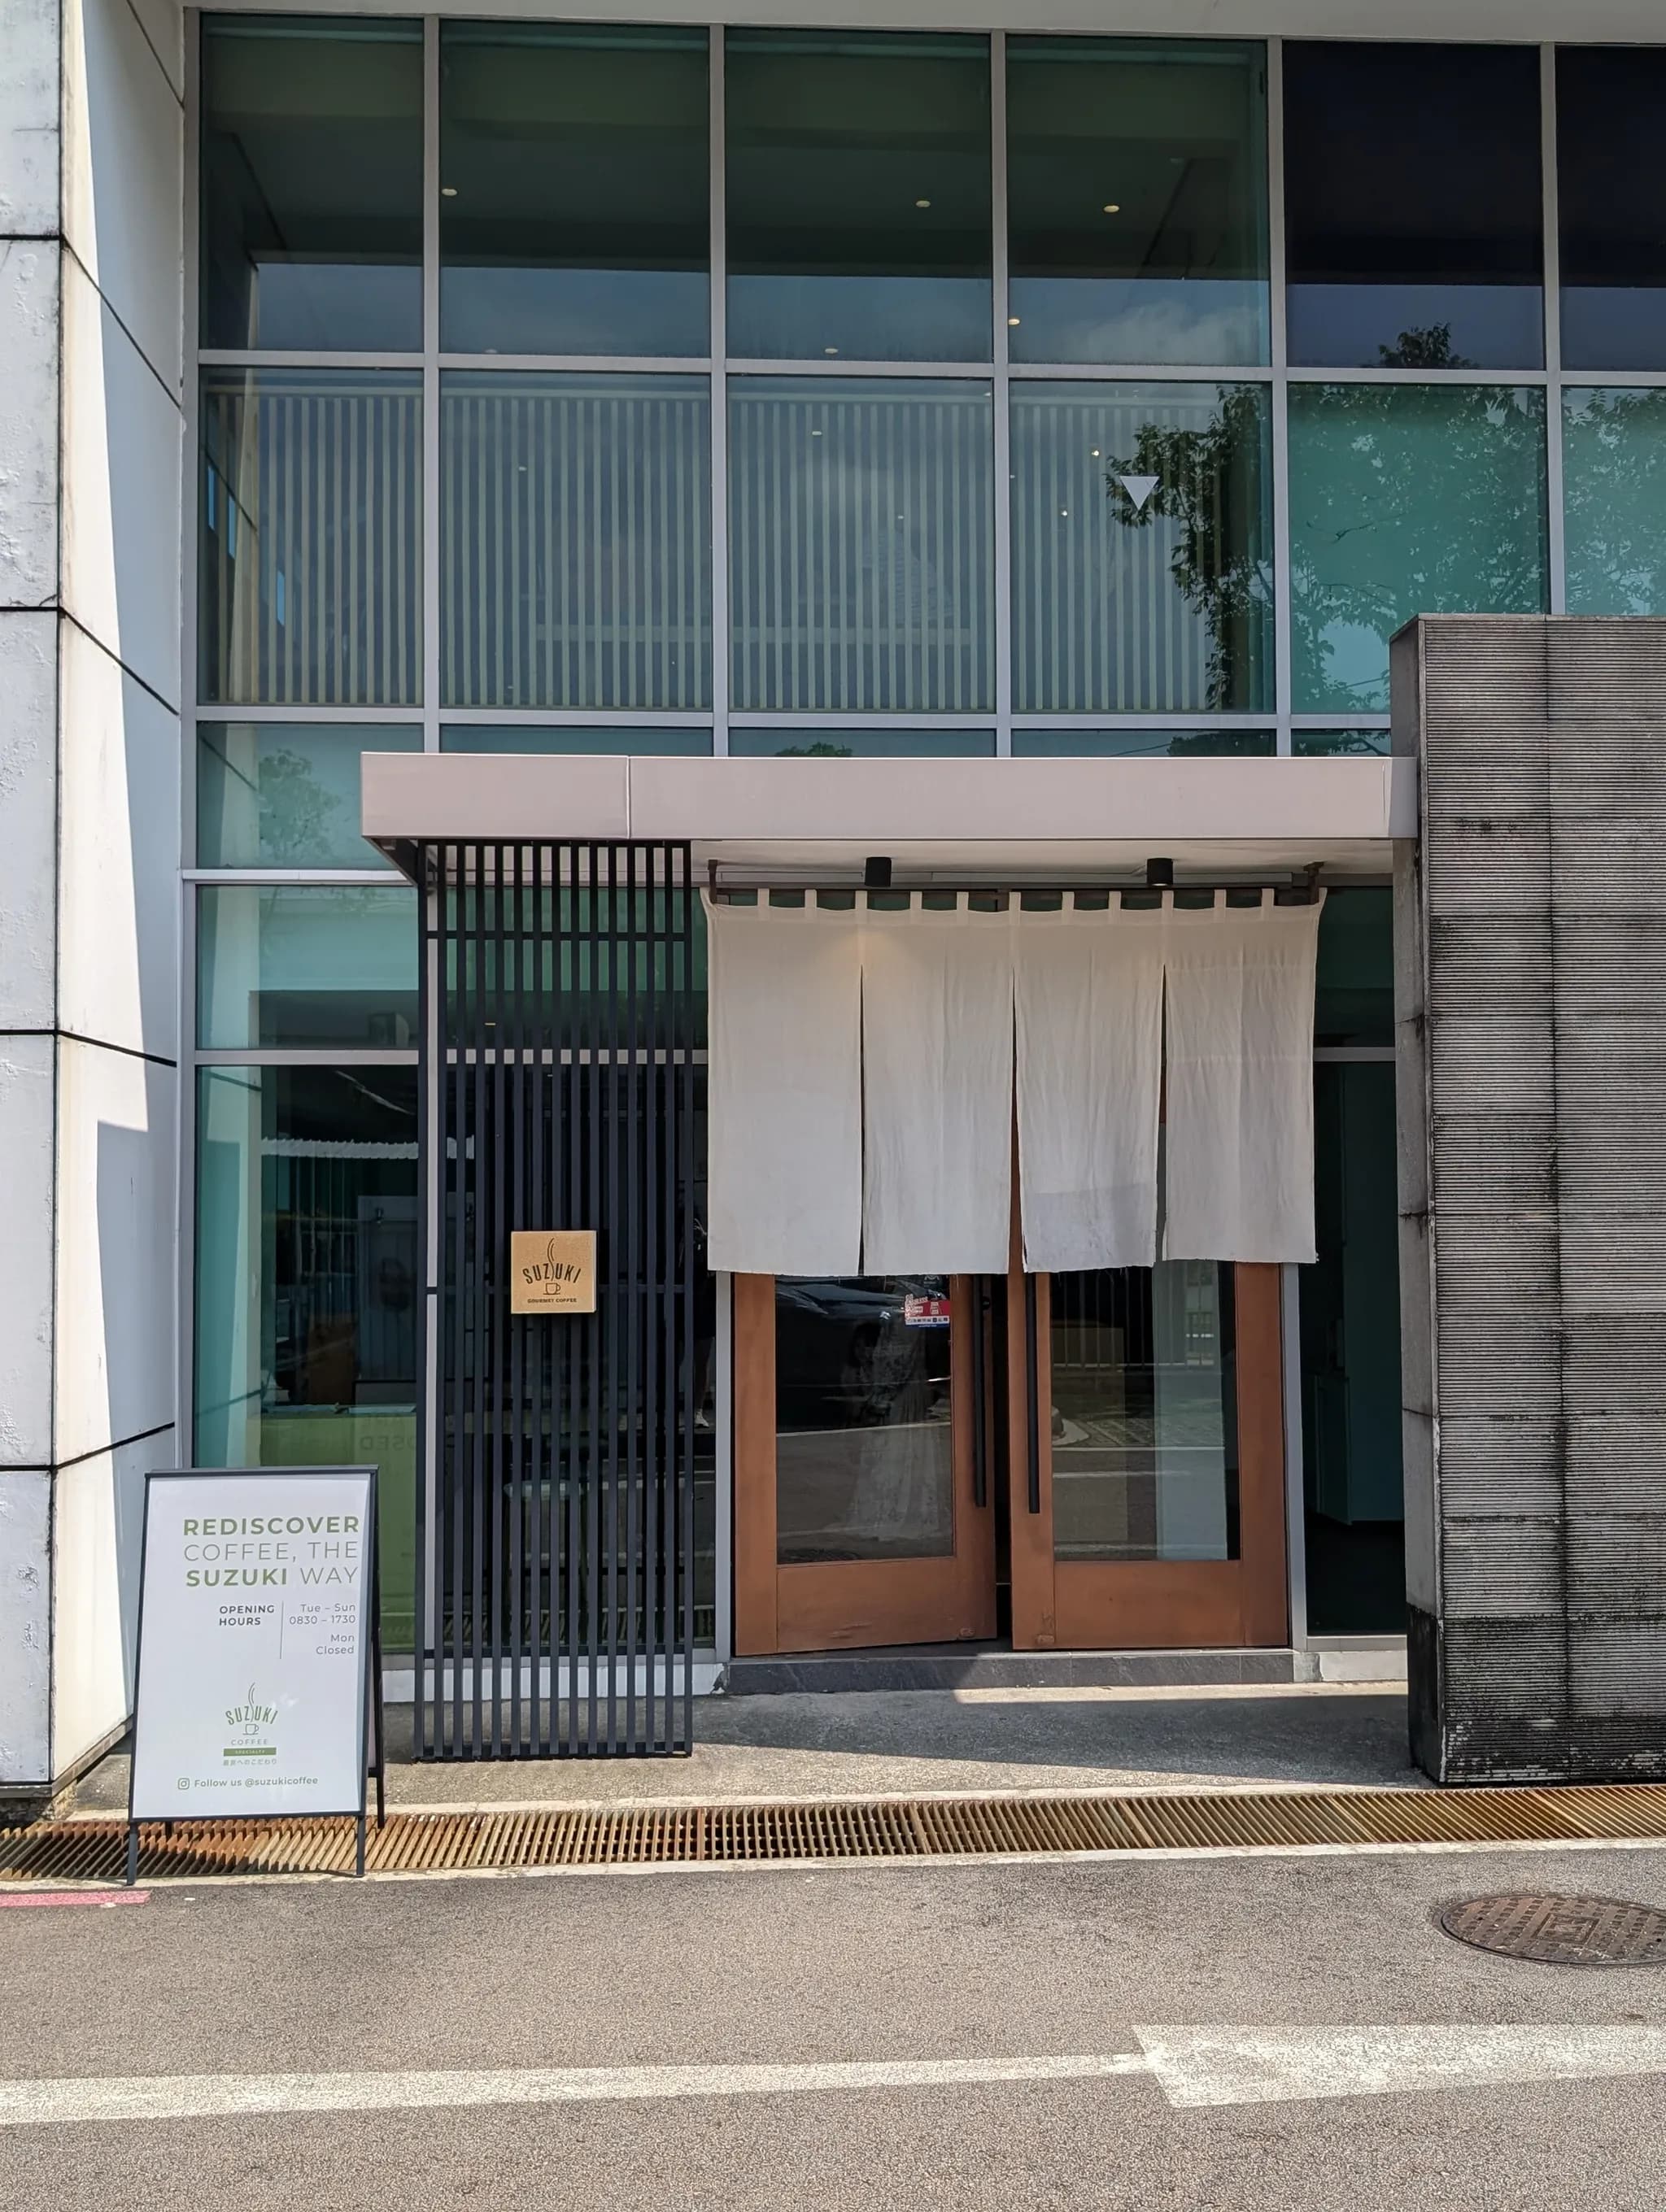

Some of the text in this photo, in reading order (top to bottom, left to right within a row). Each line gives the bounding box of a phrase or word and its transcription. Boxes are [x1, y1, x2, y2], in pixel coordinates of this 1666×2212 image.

[522, 1263, 582, 1284] SUZUKI
[183, 1516, 360, 1535] REDISCOVER
[184, 1541, 358, 1562] COFFEE, THE
[186, 1566, 358, 1587] SUZUKI WAY
[220, 1605, 275, 1614] OPENING
[301, 1604, 321, 1613] Tue
[334, 1603, 355, 1613] Sun
[219, 1617, 261, 1626] HOURS
[289, 1616, 317, 1625] 0830
[331, 1614, 356, 1624] 1730
[330, 1634, 355, 1643] Mon
[316, 1645, 355, 1655] Closed
[225, 1705, 278, 1725] SUZUKI
[194, 1775, 318, 1787] Follow us @suzukicoffee
